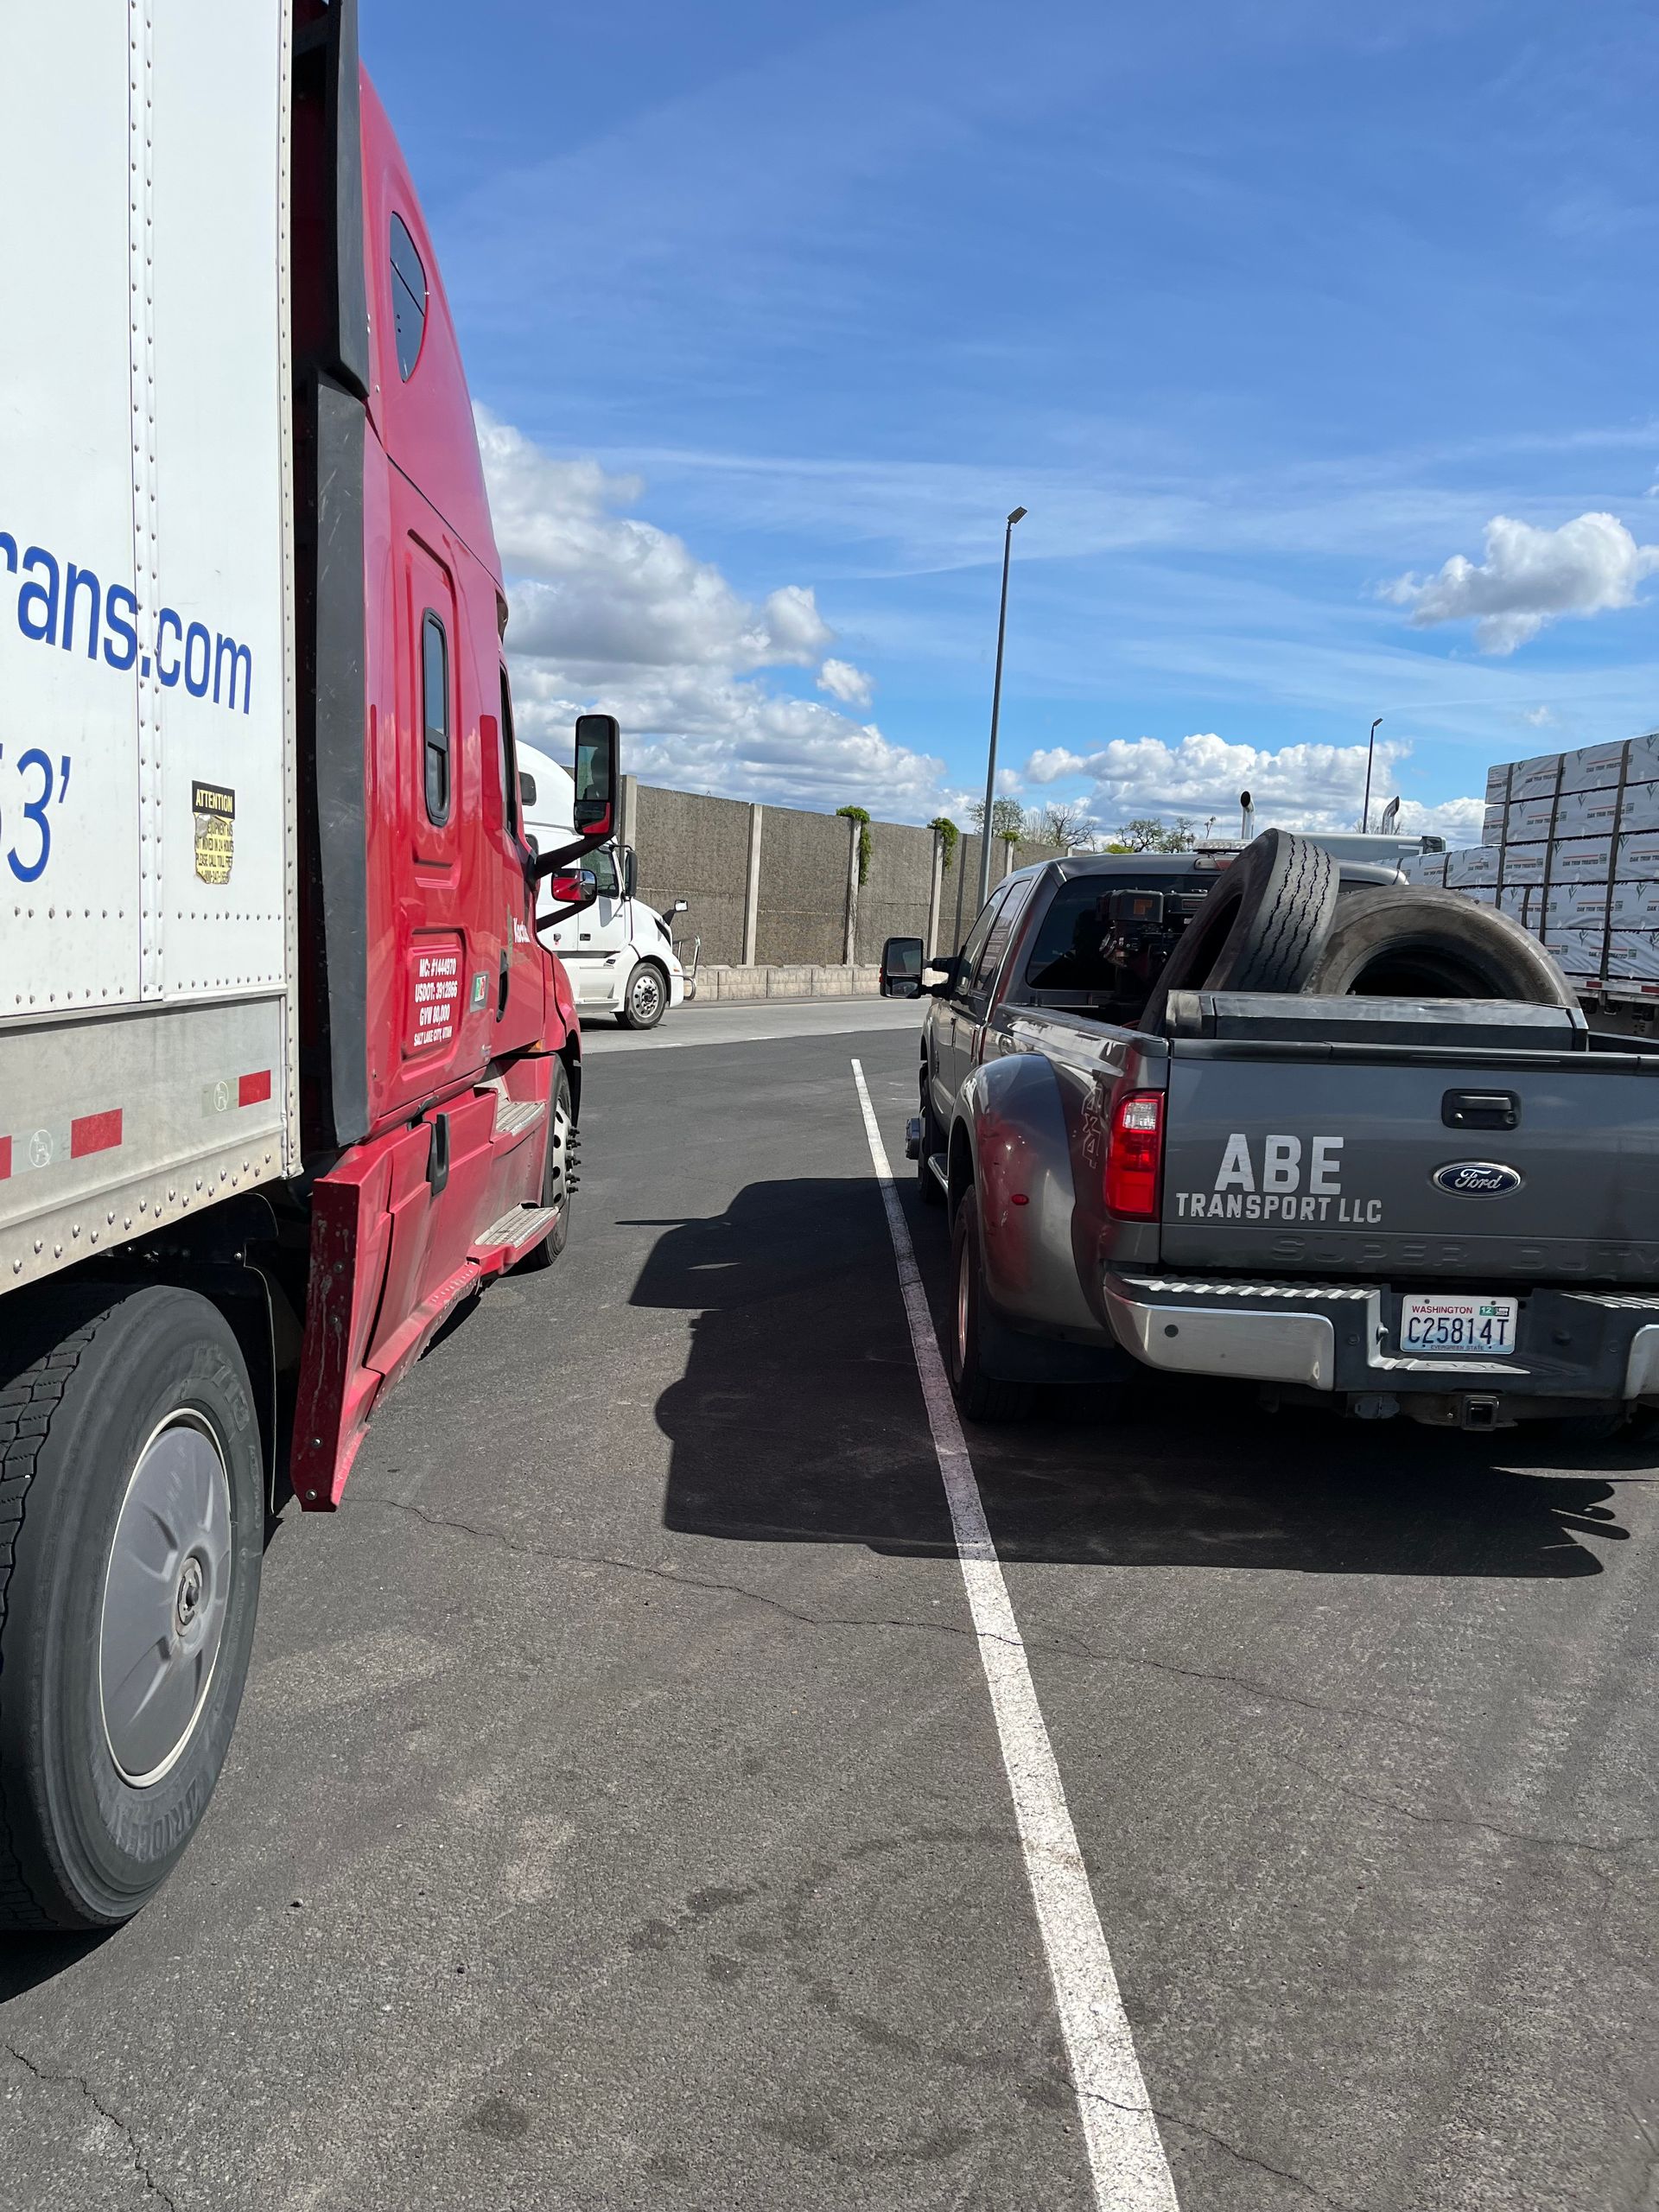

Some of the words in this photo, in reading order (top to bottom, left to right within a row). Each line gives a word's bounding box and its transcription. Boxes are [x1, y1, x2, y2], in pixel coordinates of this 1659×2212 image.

[0, 743, 71, 882] 3'
[195, 789, 233, 813] ATTENTION
[419, 958, 430, 977] MC:
[415, 982, 436, 1002] USDOT:
[432, 1004, 450, 1026] 80,000
[413, 1032, 423, 1046] SALT
[423, 1029, 434, 1044] LAKE
[1214, 1133, 1345, 1196] ABE
[1176, 1192, 1328, 1222] TRANSPORT
[1338, 1198, 1382, 1224] LLC
[1271, 1236, 1469, 1268] SUPER
[1411, 1306, 1473, 1314] WASHINGTON
[1408, 1316, 1510, 1346] C25814T
